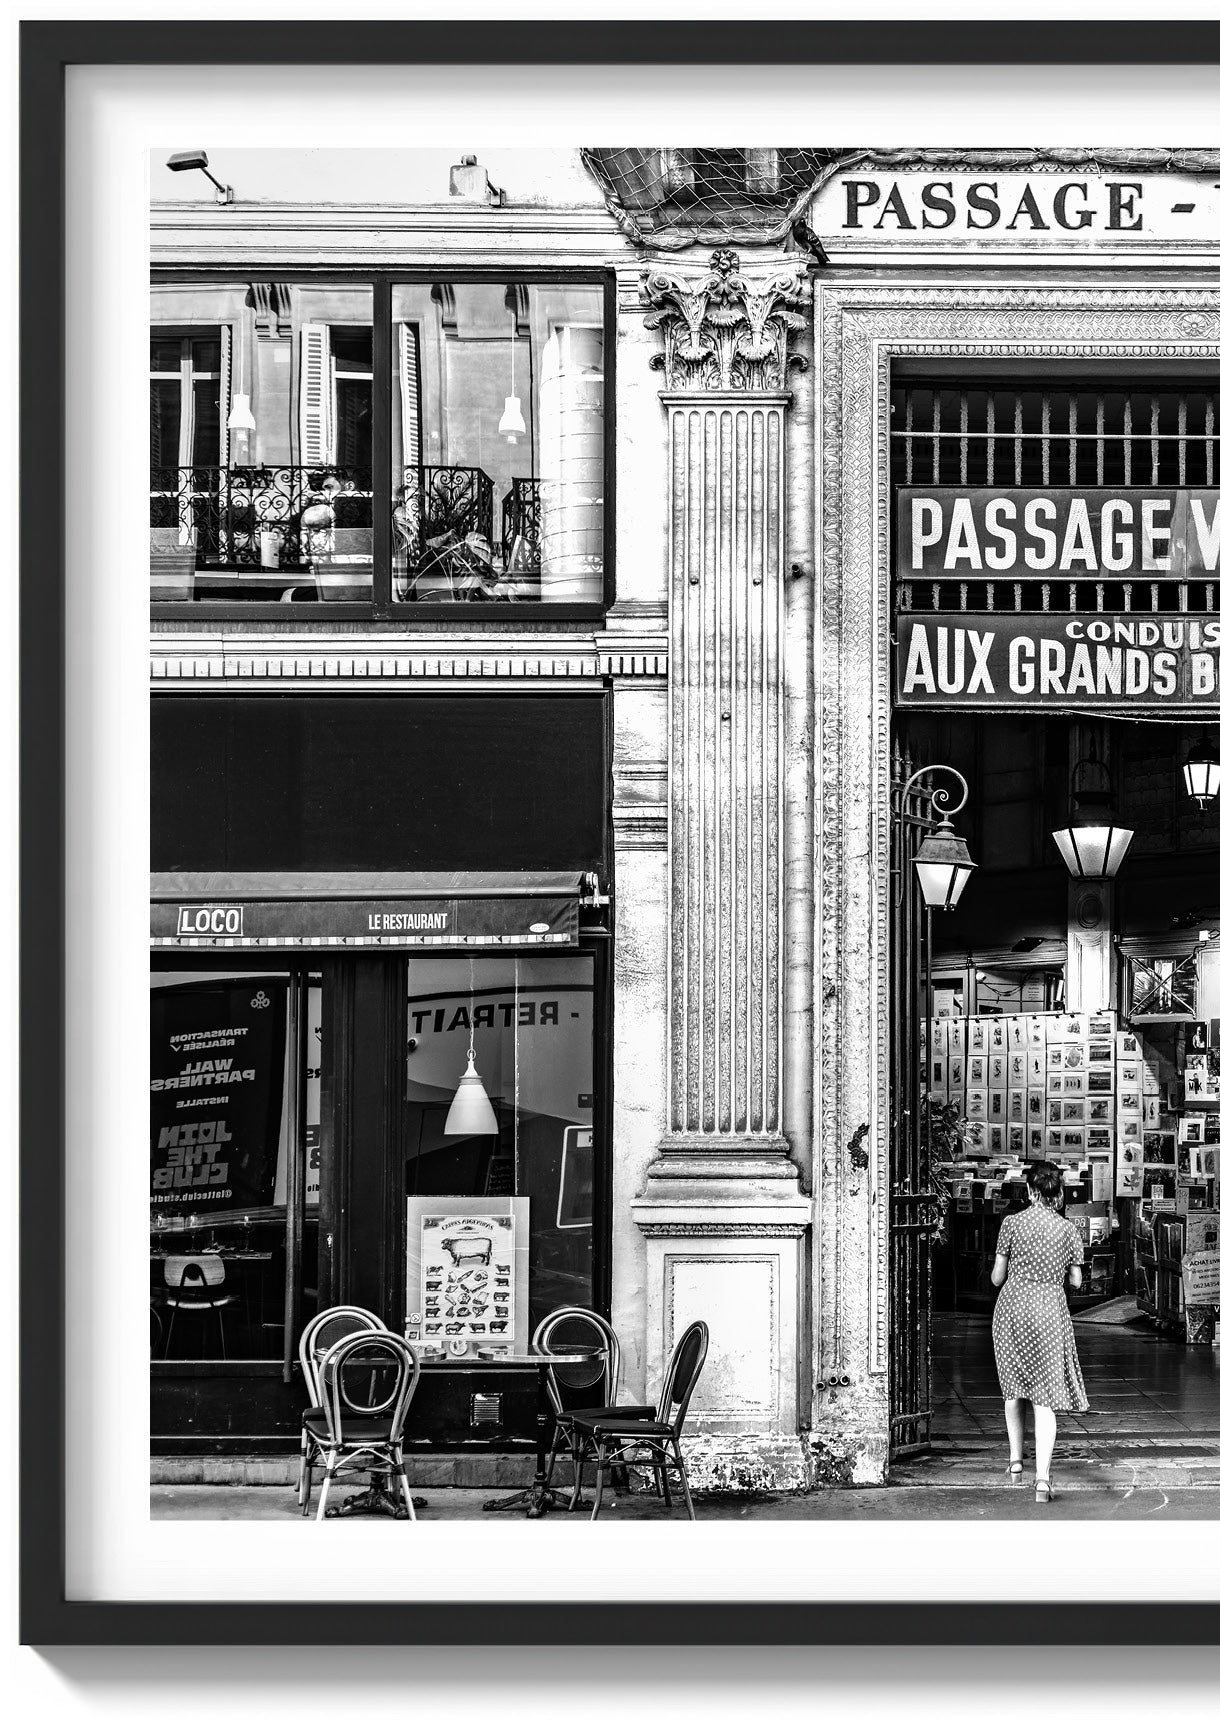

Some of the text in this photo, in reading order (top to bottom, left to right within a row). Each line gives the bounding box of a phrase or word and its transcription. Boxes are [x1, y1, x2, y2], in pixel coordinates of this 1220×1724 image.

[842, 181, 1143, 230] PASSAGE
[912, 498, 1171, 571] PASSAGE
[903, 623, 996, 694] AUX
[1009, 636, 1177, 695] GRANDS
[181, 909, 239, 933] LOCO
[368, 913, 448, 930] LE RESTAURANT
